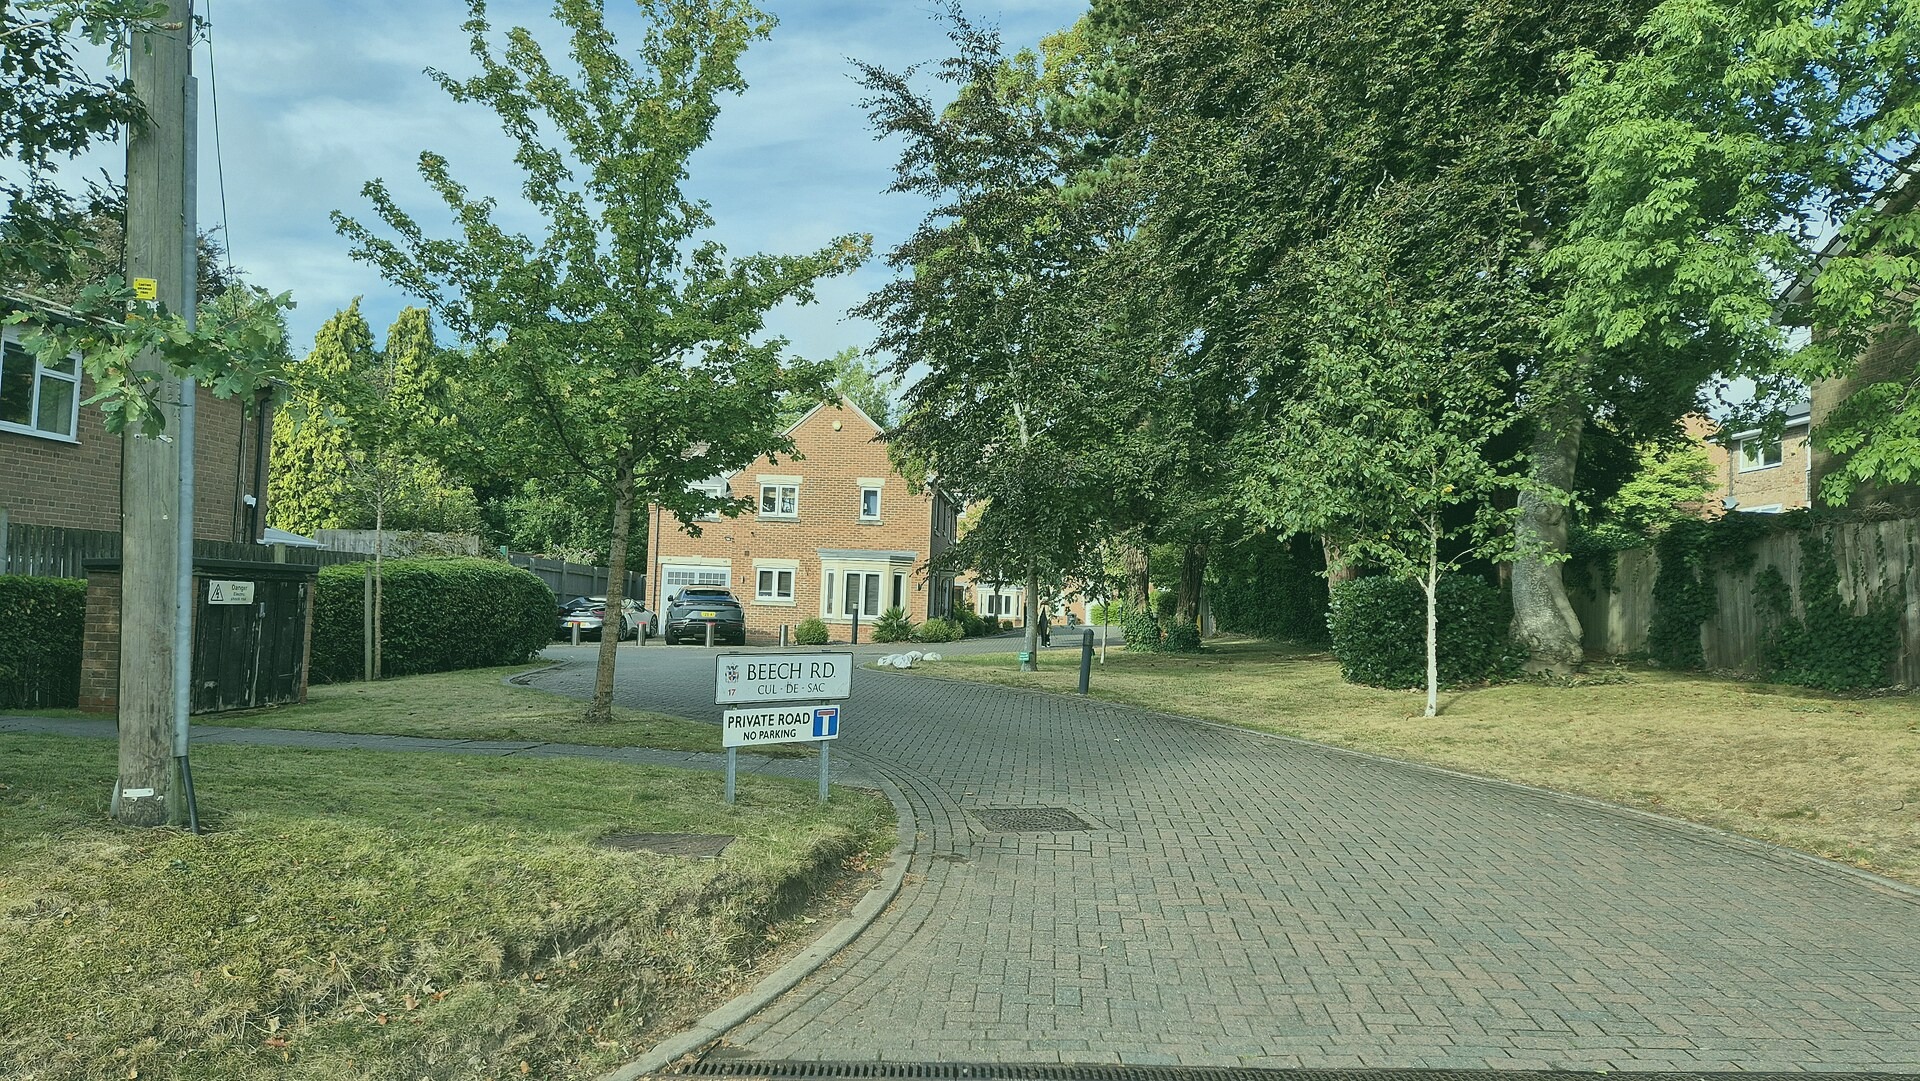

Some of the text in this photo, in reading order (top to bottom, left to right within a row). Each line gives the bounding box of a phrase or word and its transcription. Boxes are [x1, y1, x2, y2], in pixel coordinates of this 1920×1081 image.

[231, 584, 248, 592] Danger
[747, 662, 836, 681] BEECH RD.
[728, 688, 736, 696] 17
[757, 682, 826, 695] CUL DE SAC
[727, 712, 811, 729] PRIVATE ROAD
[743, 728, 797, 741] NO PARKING
